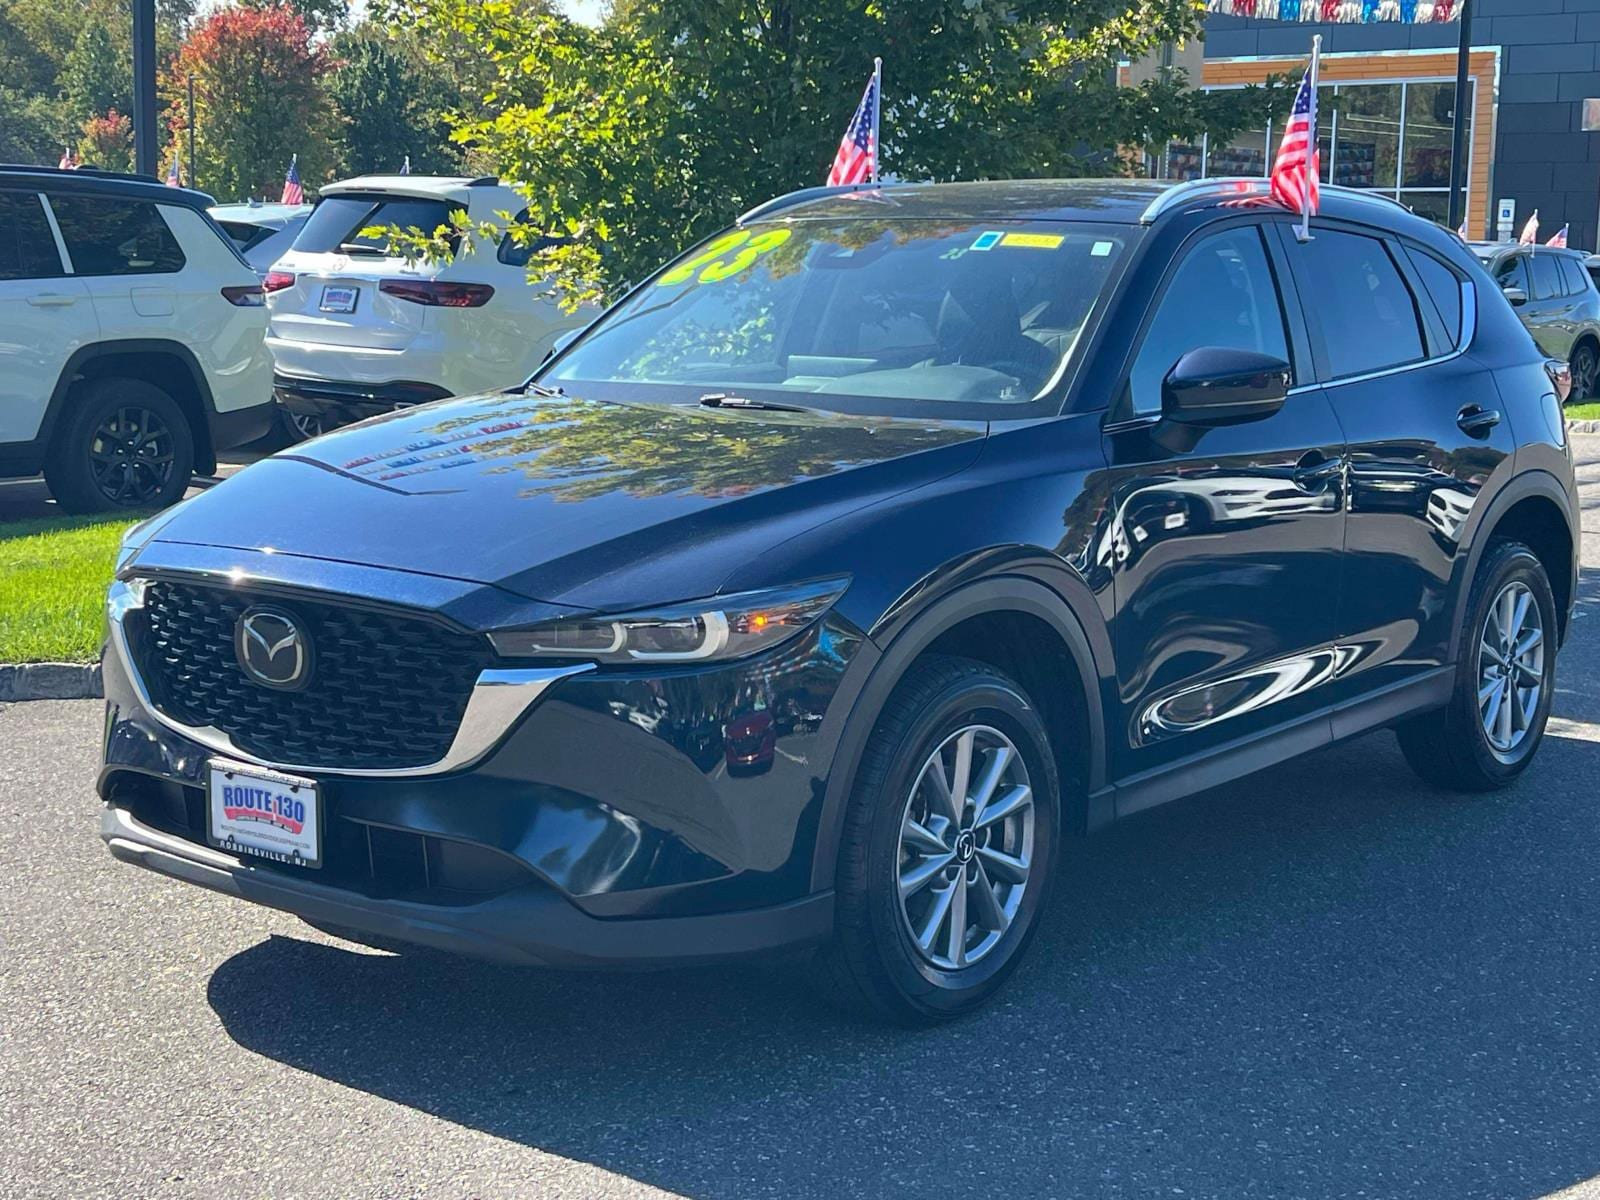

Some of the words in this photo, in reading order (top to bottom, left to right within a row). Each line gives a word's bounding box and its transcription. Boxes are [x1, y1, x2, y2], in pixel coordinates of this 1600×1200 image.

[656, 229, 792, 286] 23
[223, 787, 272, 812] ROUTE
[275, 795, 304, 823] 130
[219, 840, 291, 864] ROBBINSVILLE,
[295, 857, 307, 867] NJ
